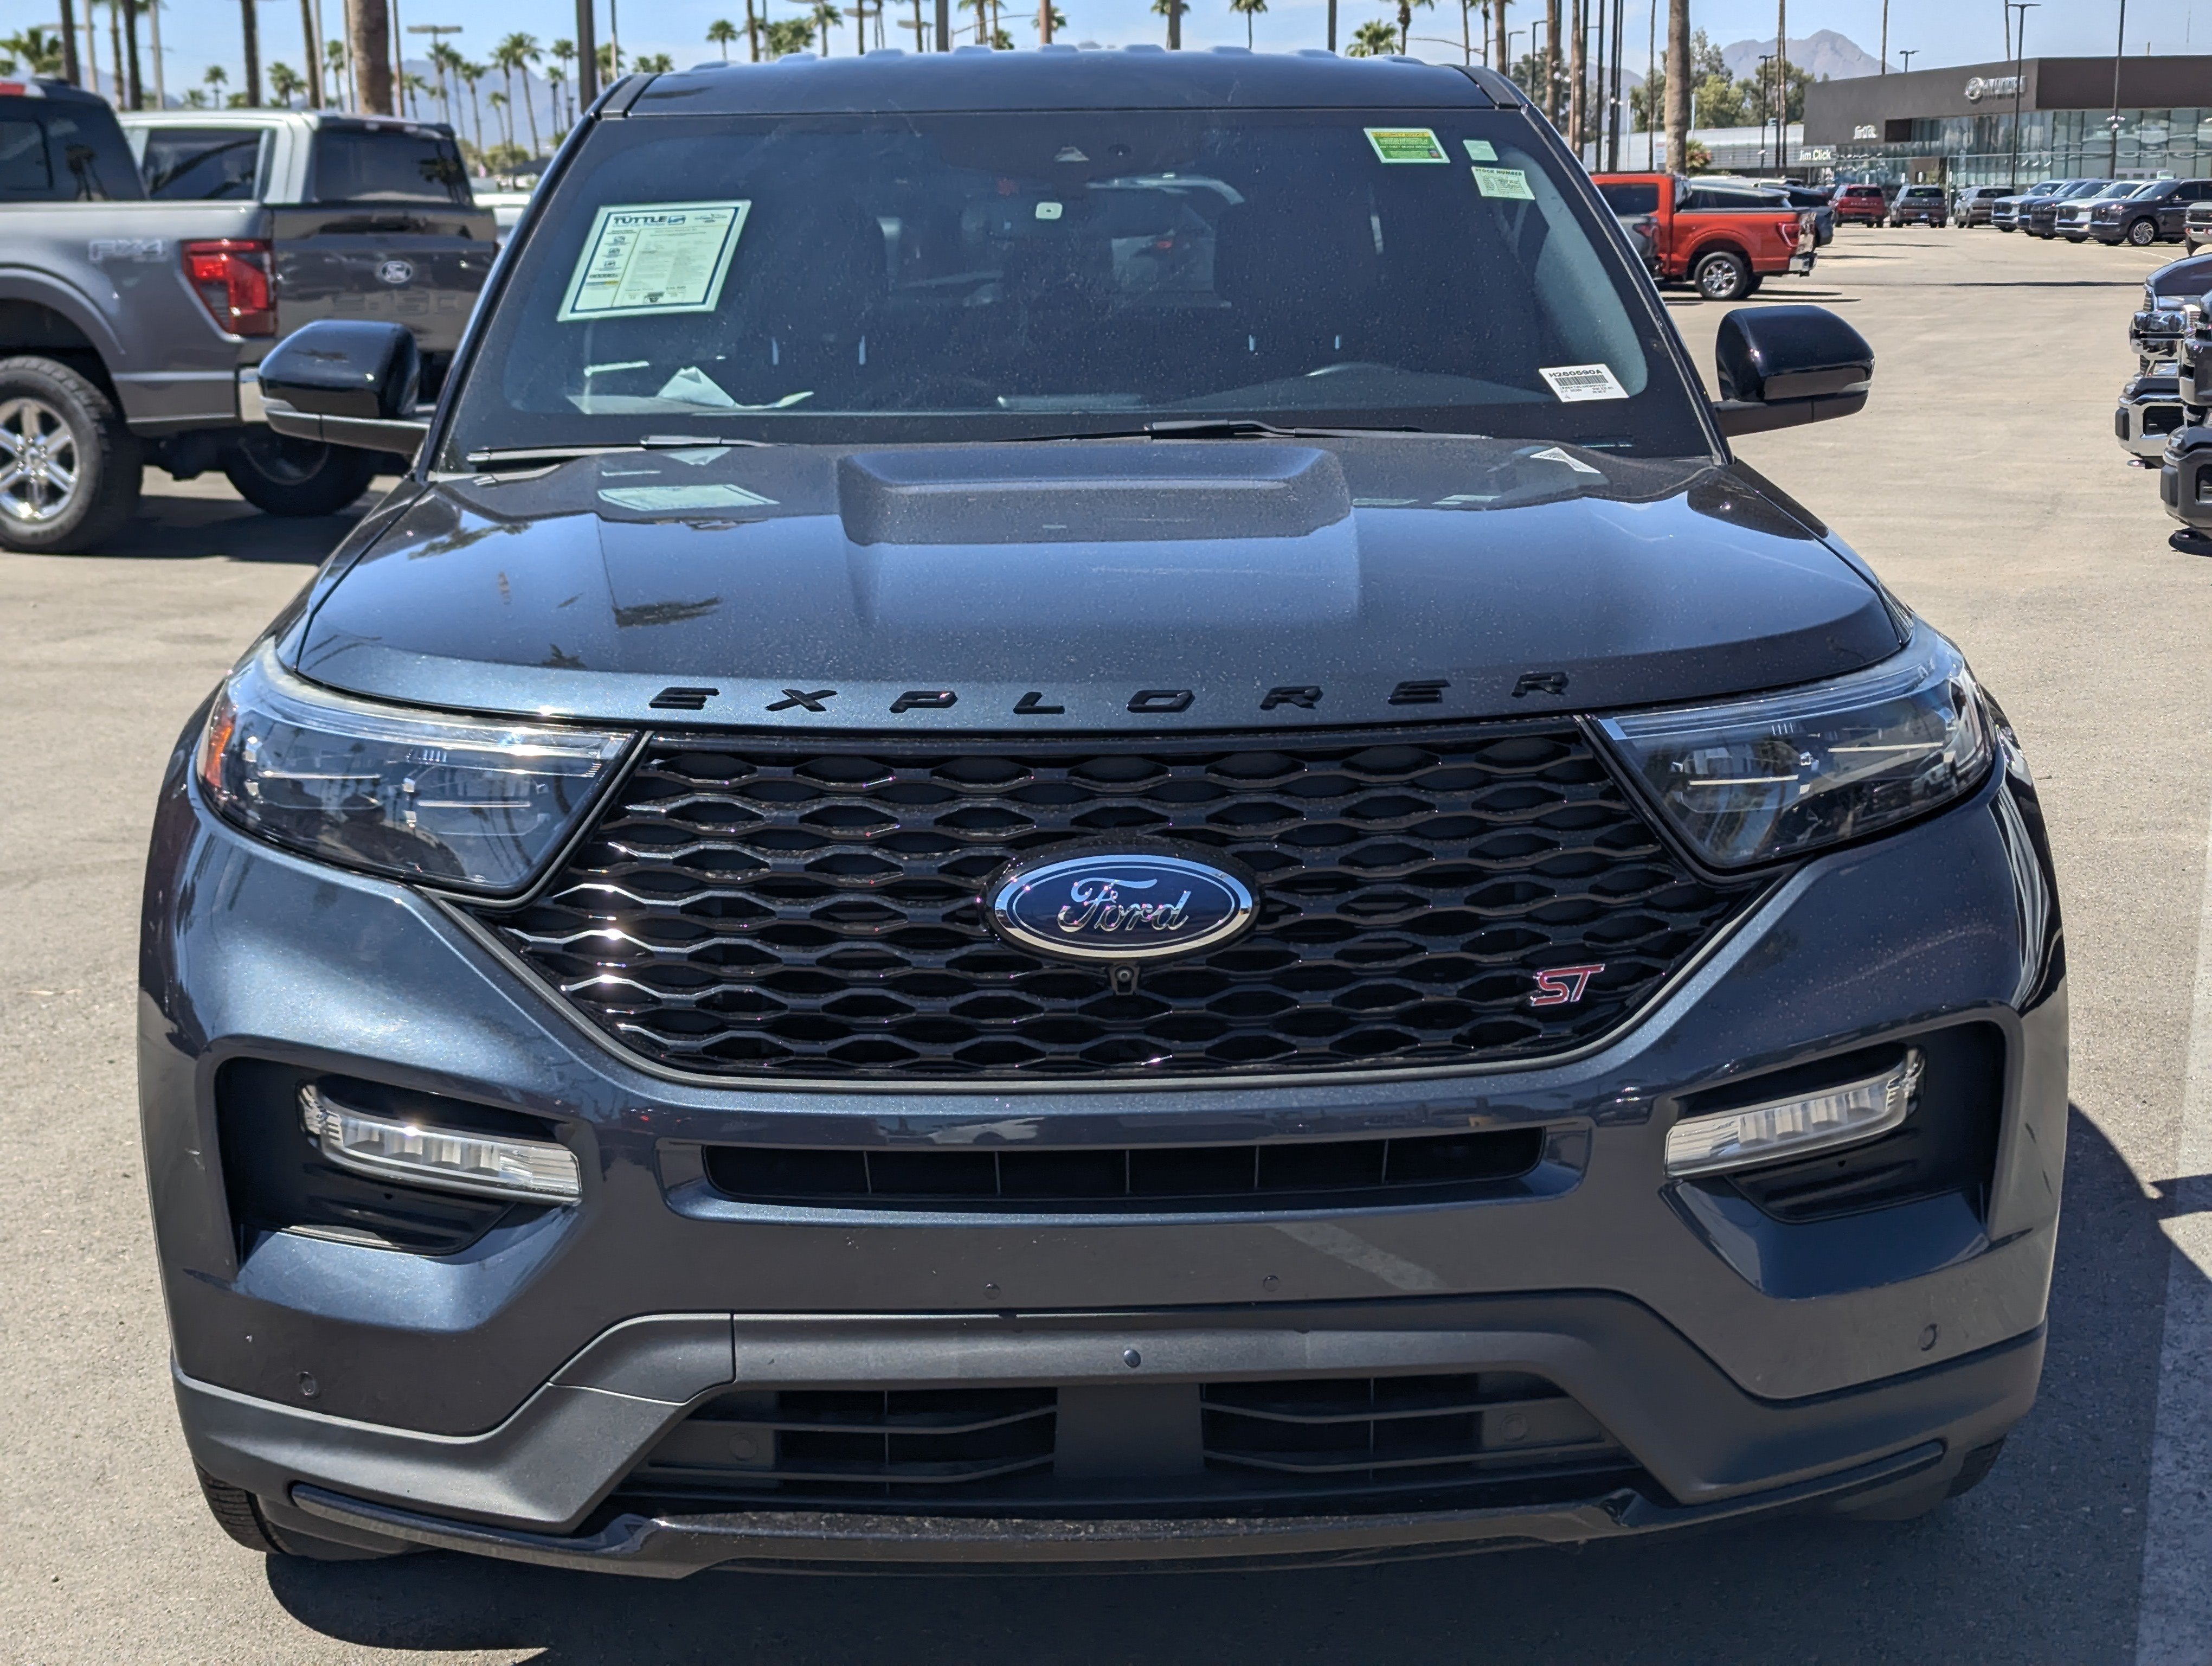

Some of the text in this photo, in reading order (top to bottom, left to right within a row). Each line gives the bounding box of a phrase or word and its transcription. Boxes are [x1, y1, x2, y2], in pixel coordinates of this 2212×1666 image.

[1799, 149, 1831, 161] Jim Click
[613, 215, 668, 225] TUTTLE
[648, 671, 1569, 715] EXPLORER
[1058, 877, 1191, 932] Ford
[1530, 963, 1606, 1007] ST
